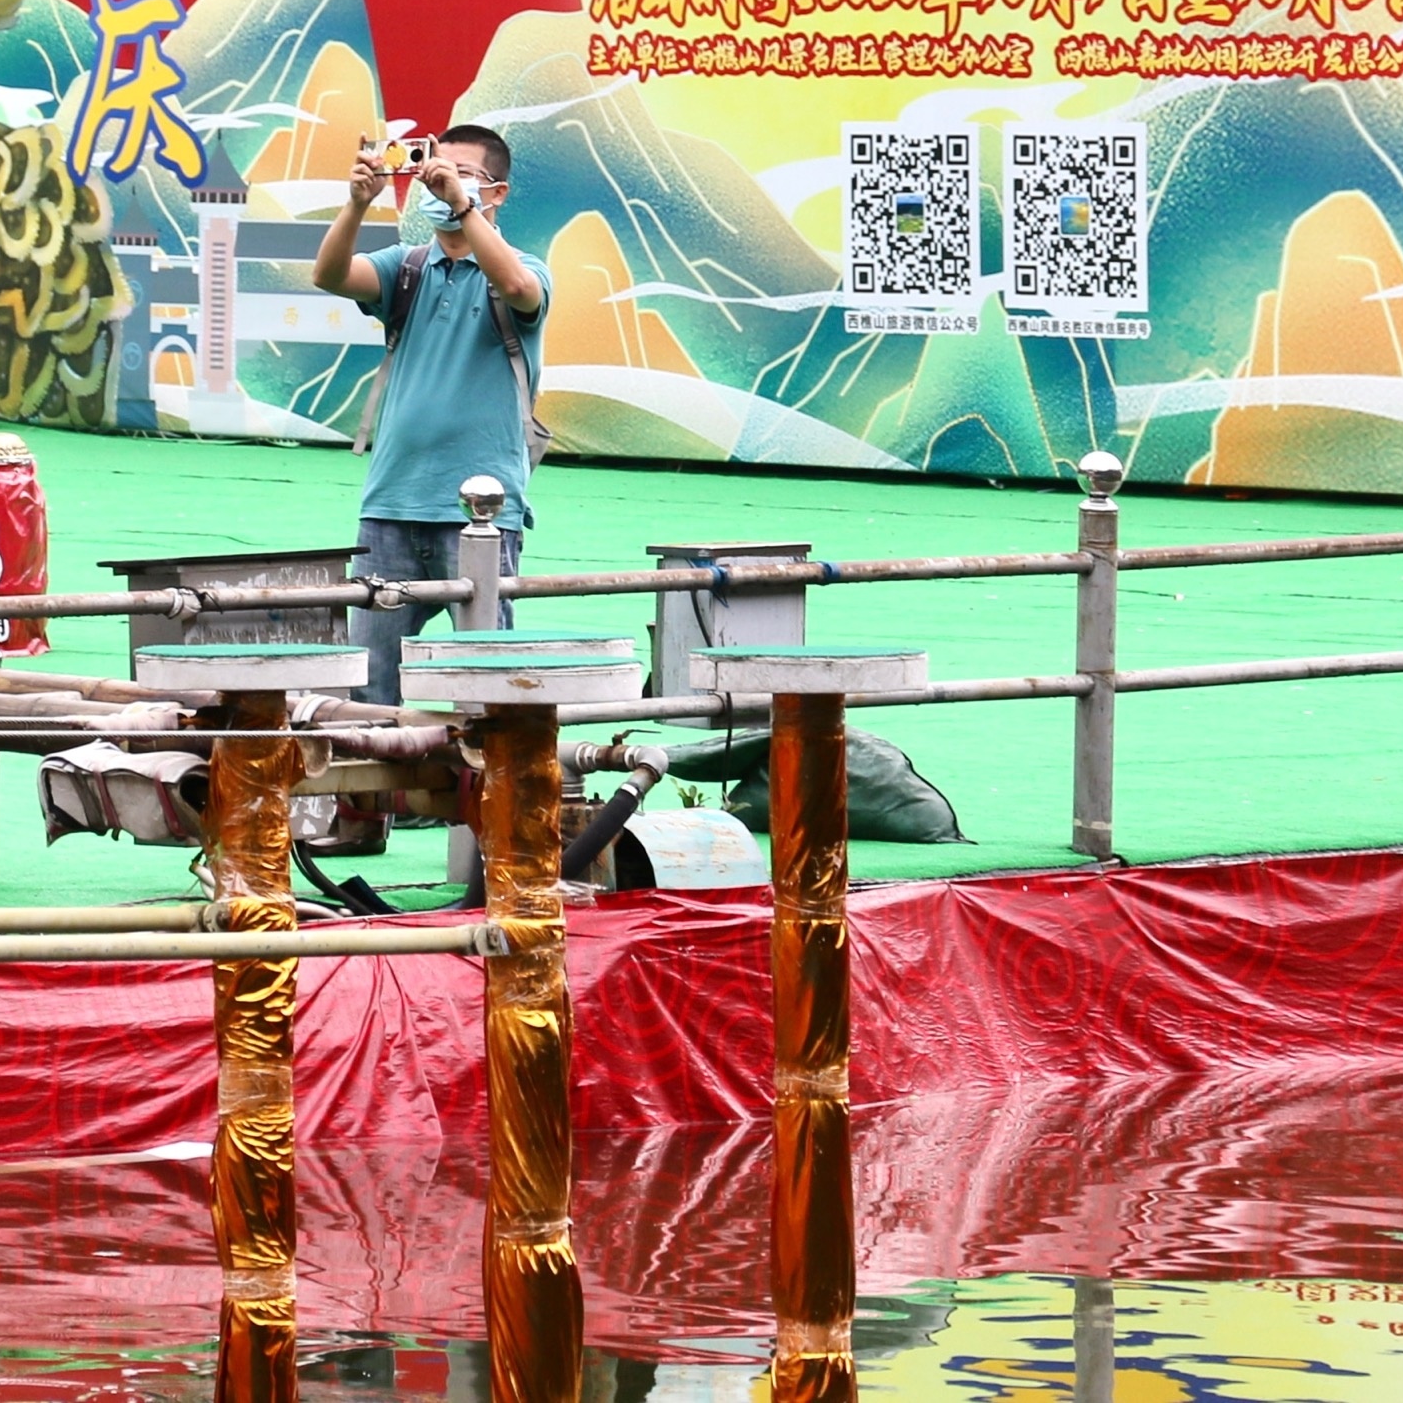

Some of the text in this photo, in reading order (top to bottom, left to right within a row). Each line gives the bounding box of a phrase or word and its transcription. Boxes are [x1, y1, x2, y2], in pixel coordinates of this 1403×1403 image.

[847, 313, 979, 333] 西樵山旅游微信公众号
[1007, 318, 1148, 337] 西樵山风景名胜区微信服务号
